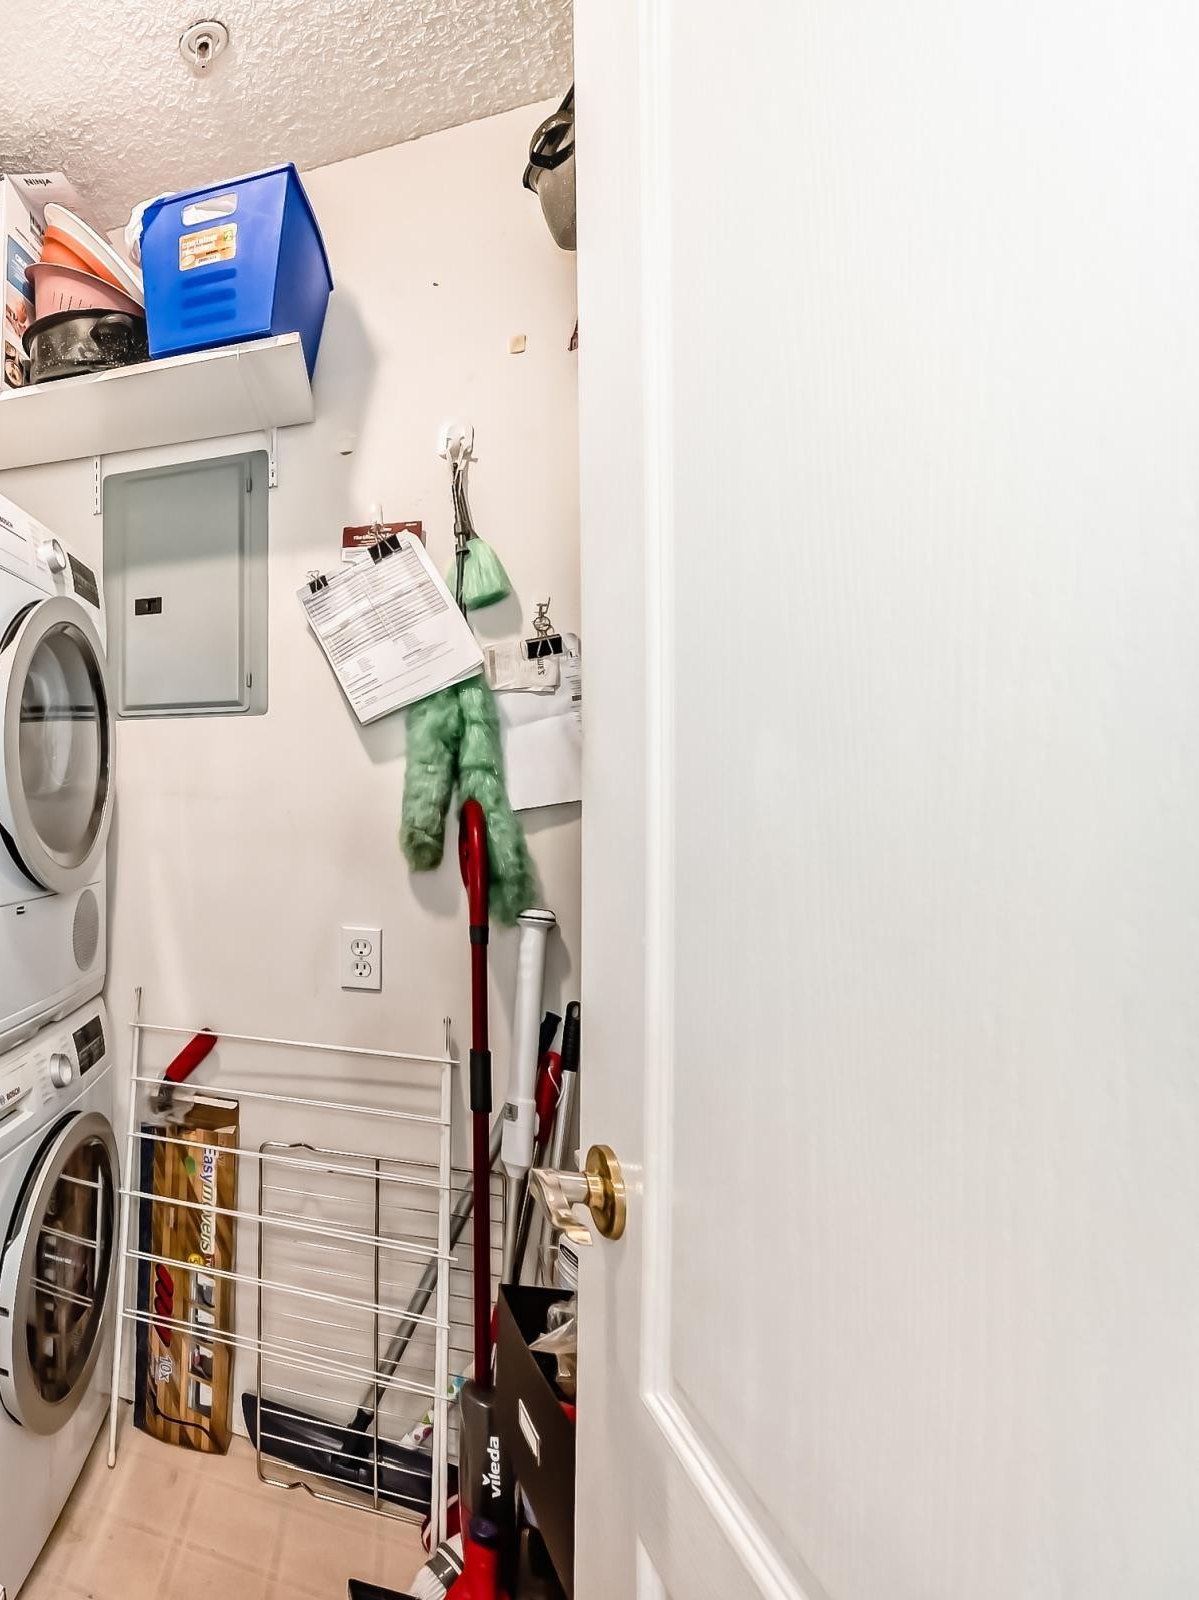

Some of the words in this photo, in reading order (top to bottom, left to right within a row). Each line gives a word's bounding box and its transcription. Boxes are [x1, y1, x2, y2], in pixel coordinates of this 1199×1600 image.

[23, 178, 52, 187] NINJA
[6, 1086, 20, 1100] BOSCH
[483, 1435, 502, 1499] vileda
